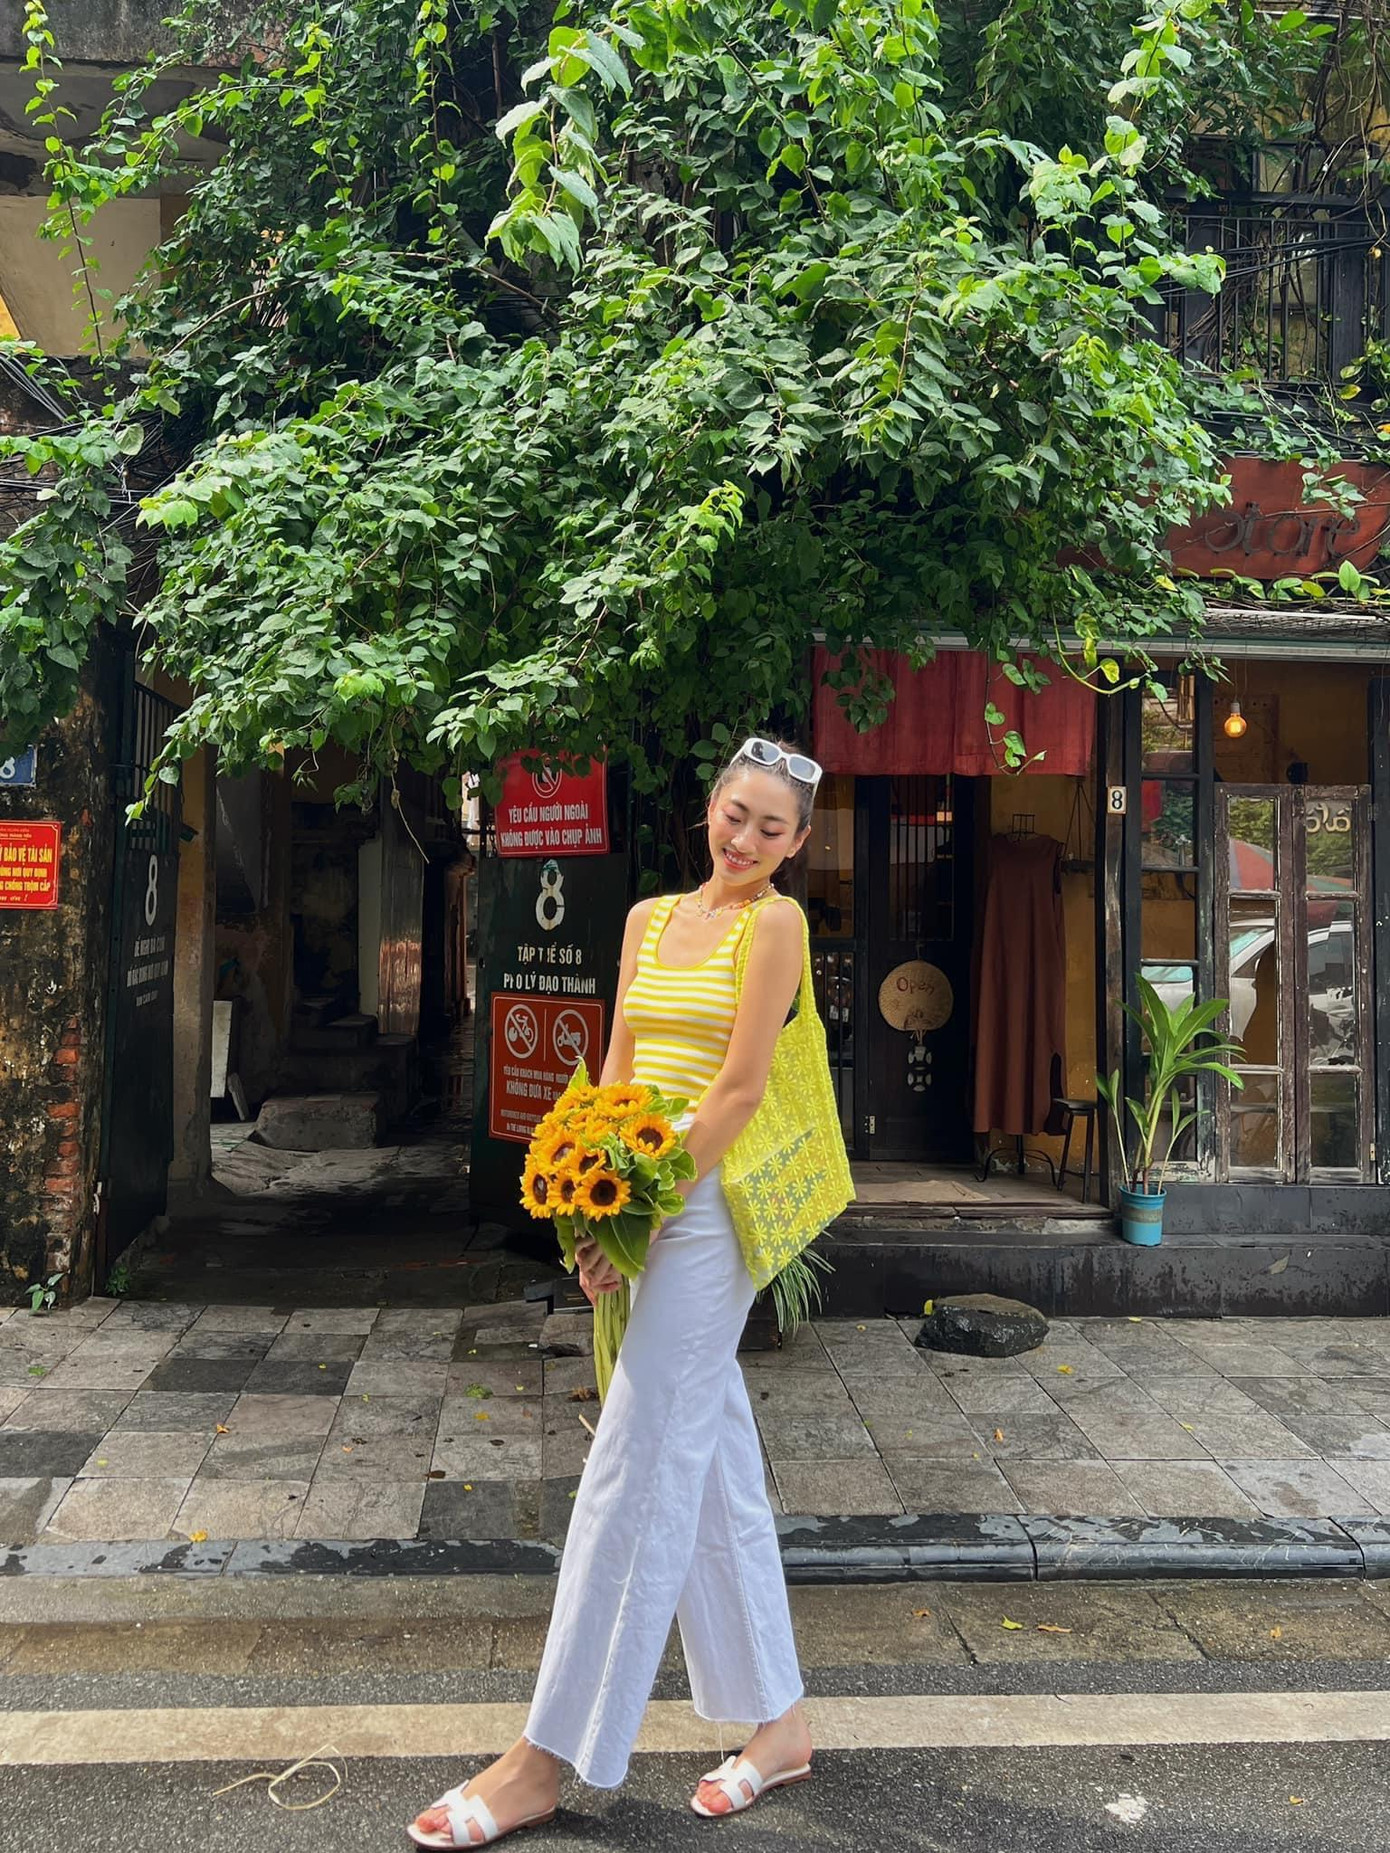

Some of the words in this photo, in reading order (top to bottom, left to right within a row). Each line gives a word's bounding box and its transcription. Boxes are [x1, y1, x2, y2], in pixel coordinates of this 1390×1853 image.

[1112, 790, 1122, 810] 8
[508, 805, 522, 824] YÊU
[564, 800, 588, 820] NGOÀI
[500, 829, 523, 847] KHÔNG
[545, 826, 560, 846] VÀO
[562, 828, 582, 848] CHỤP
[145, 854, 158, 926] 8
[536, 859, 565, 931] 8
[517, 943, 536, 965] TẬP
[559, 944, 574, 964] SỐ
[576, 949, 582, 965] 8
[525, 971, 536, 990] LÝ
[896, 977, 935, 996] Open
[543, 1086, 552, 1100] XE
